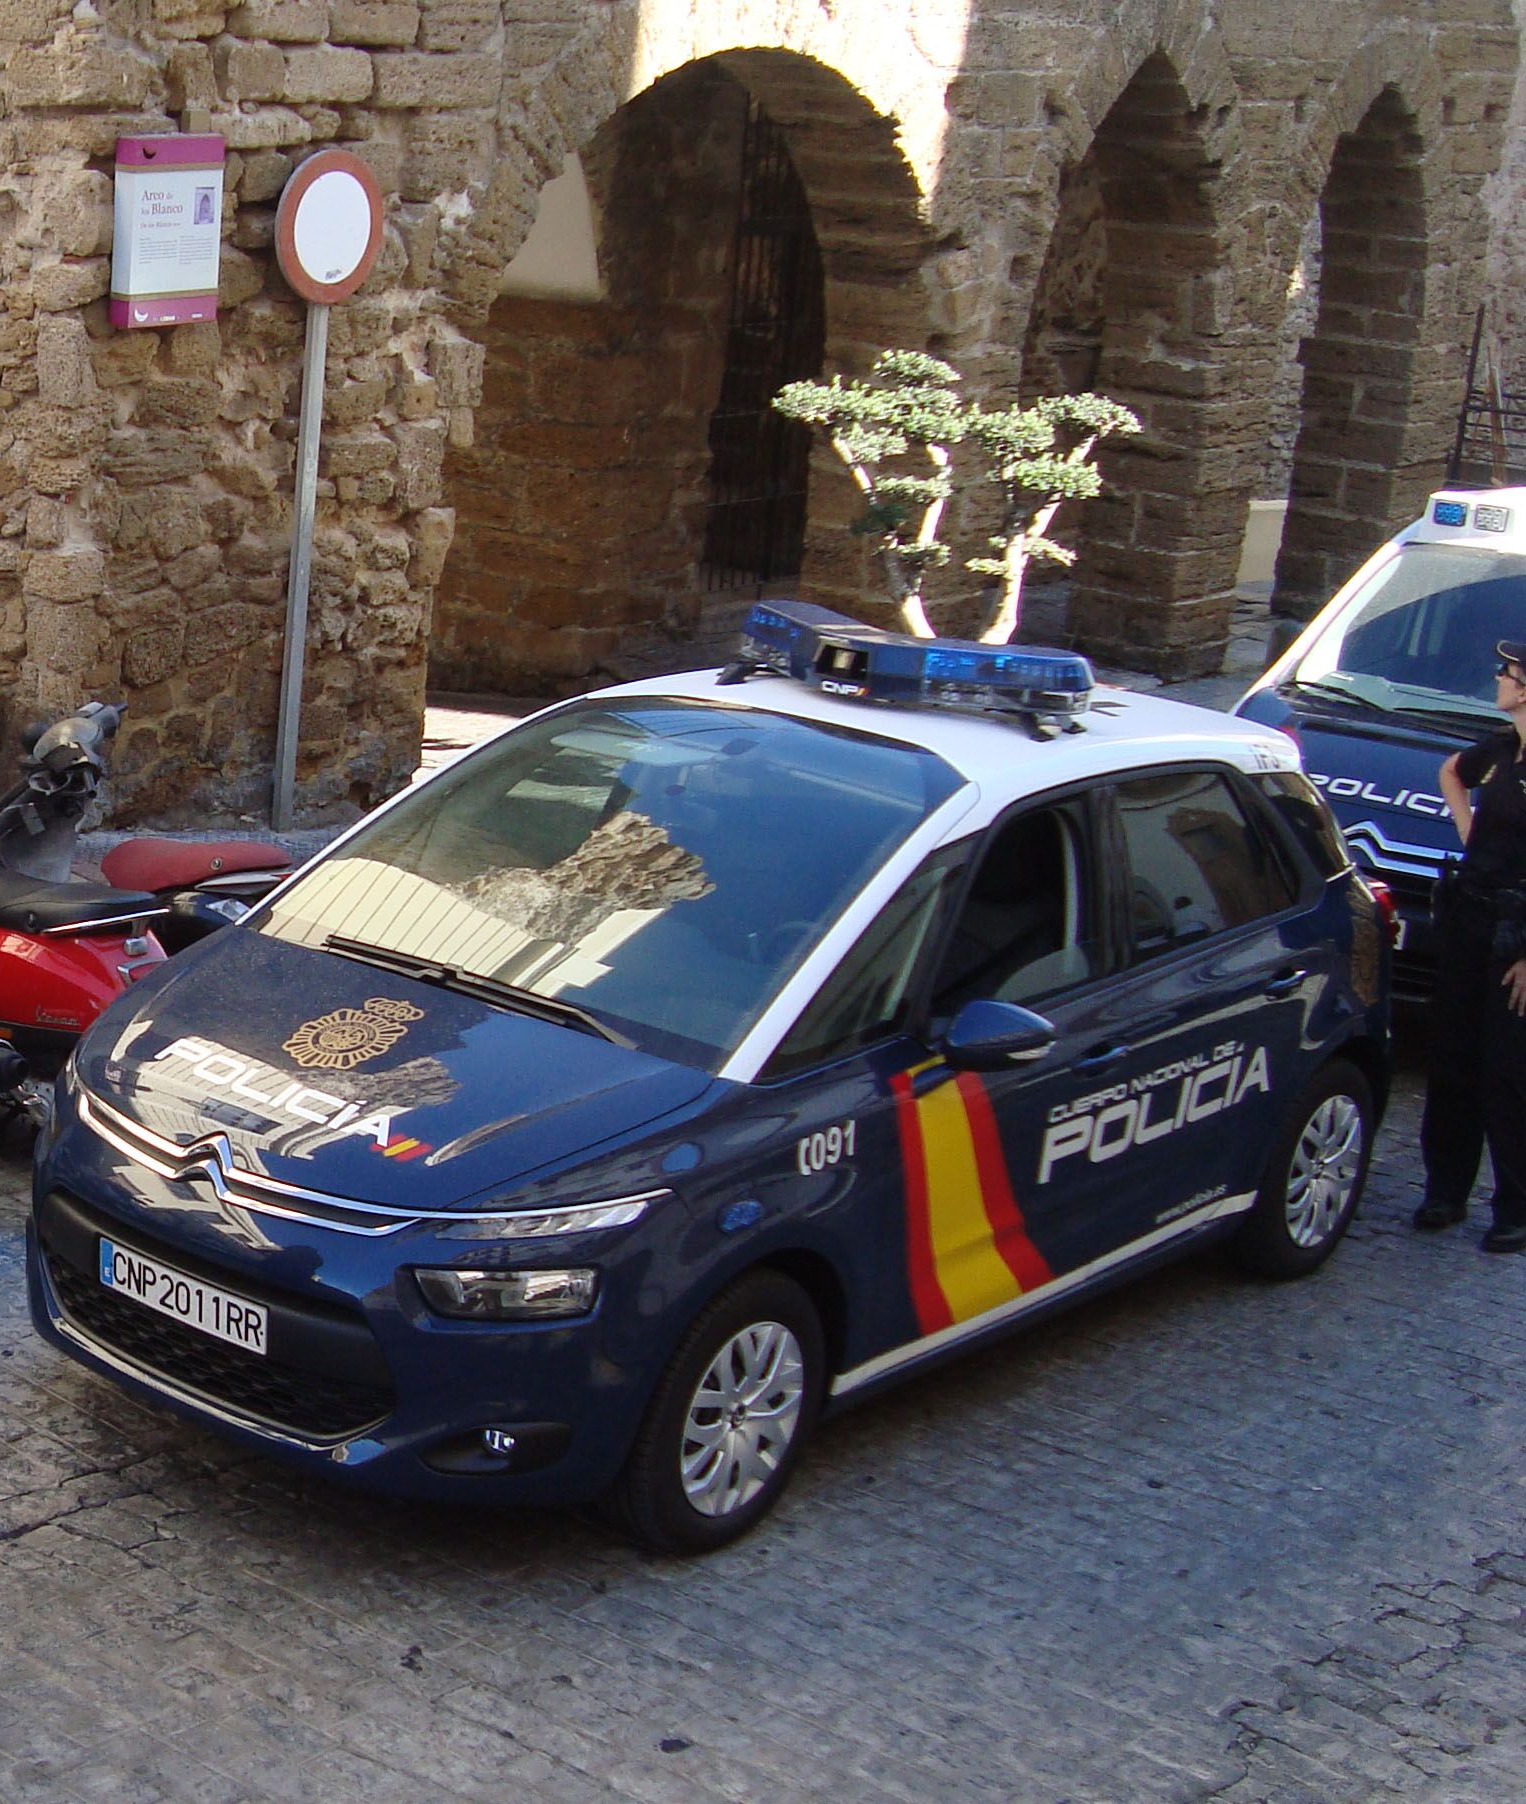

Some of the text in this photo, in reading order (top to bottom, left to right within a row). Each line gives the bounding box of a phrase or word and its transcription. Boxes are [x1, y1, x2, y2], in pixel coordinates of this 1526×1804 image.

[141, 190, 164, 201] Arco
[152, 203, 183, 215] Blanco
[822, 680, 859, 695] CNP
[1309, 773, 1475, 819] POLICI
[1049, 1040, 1237, 1123] CUERPO NACIONAL DE
